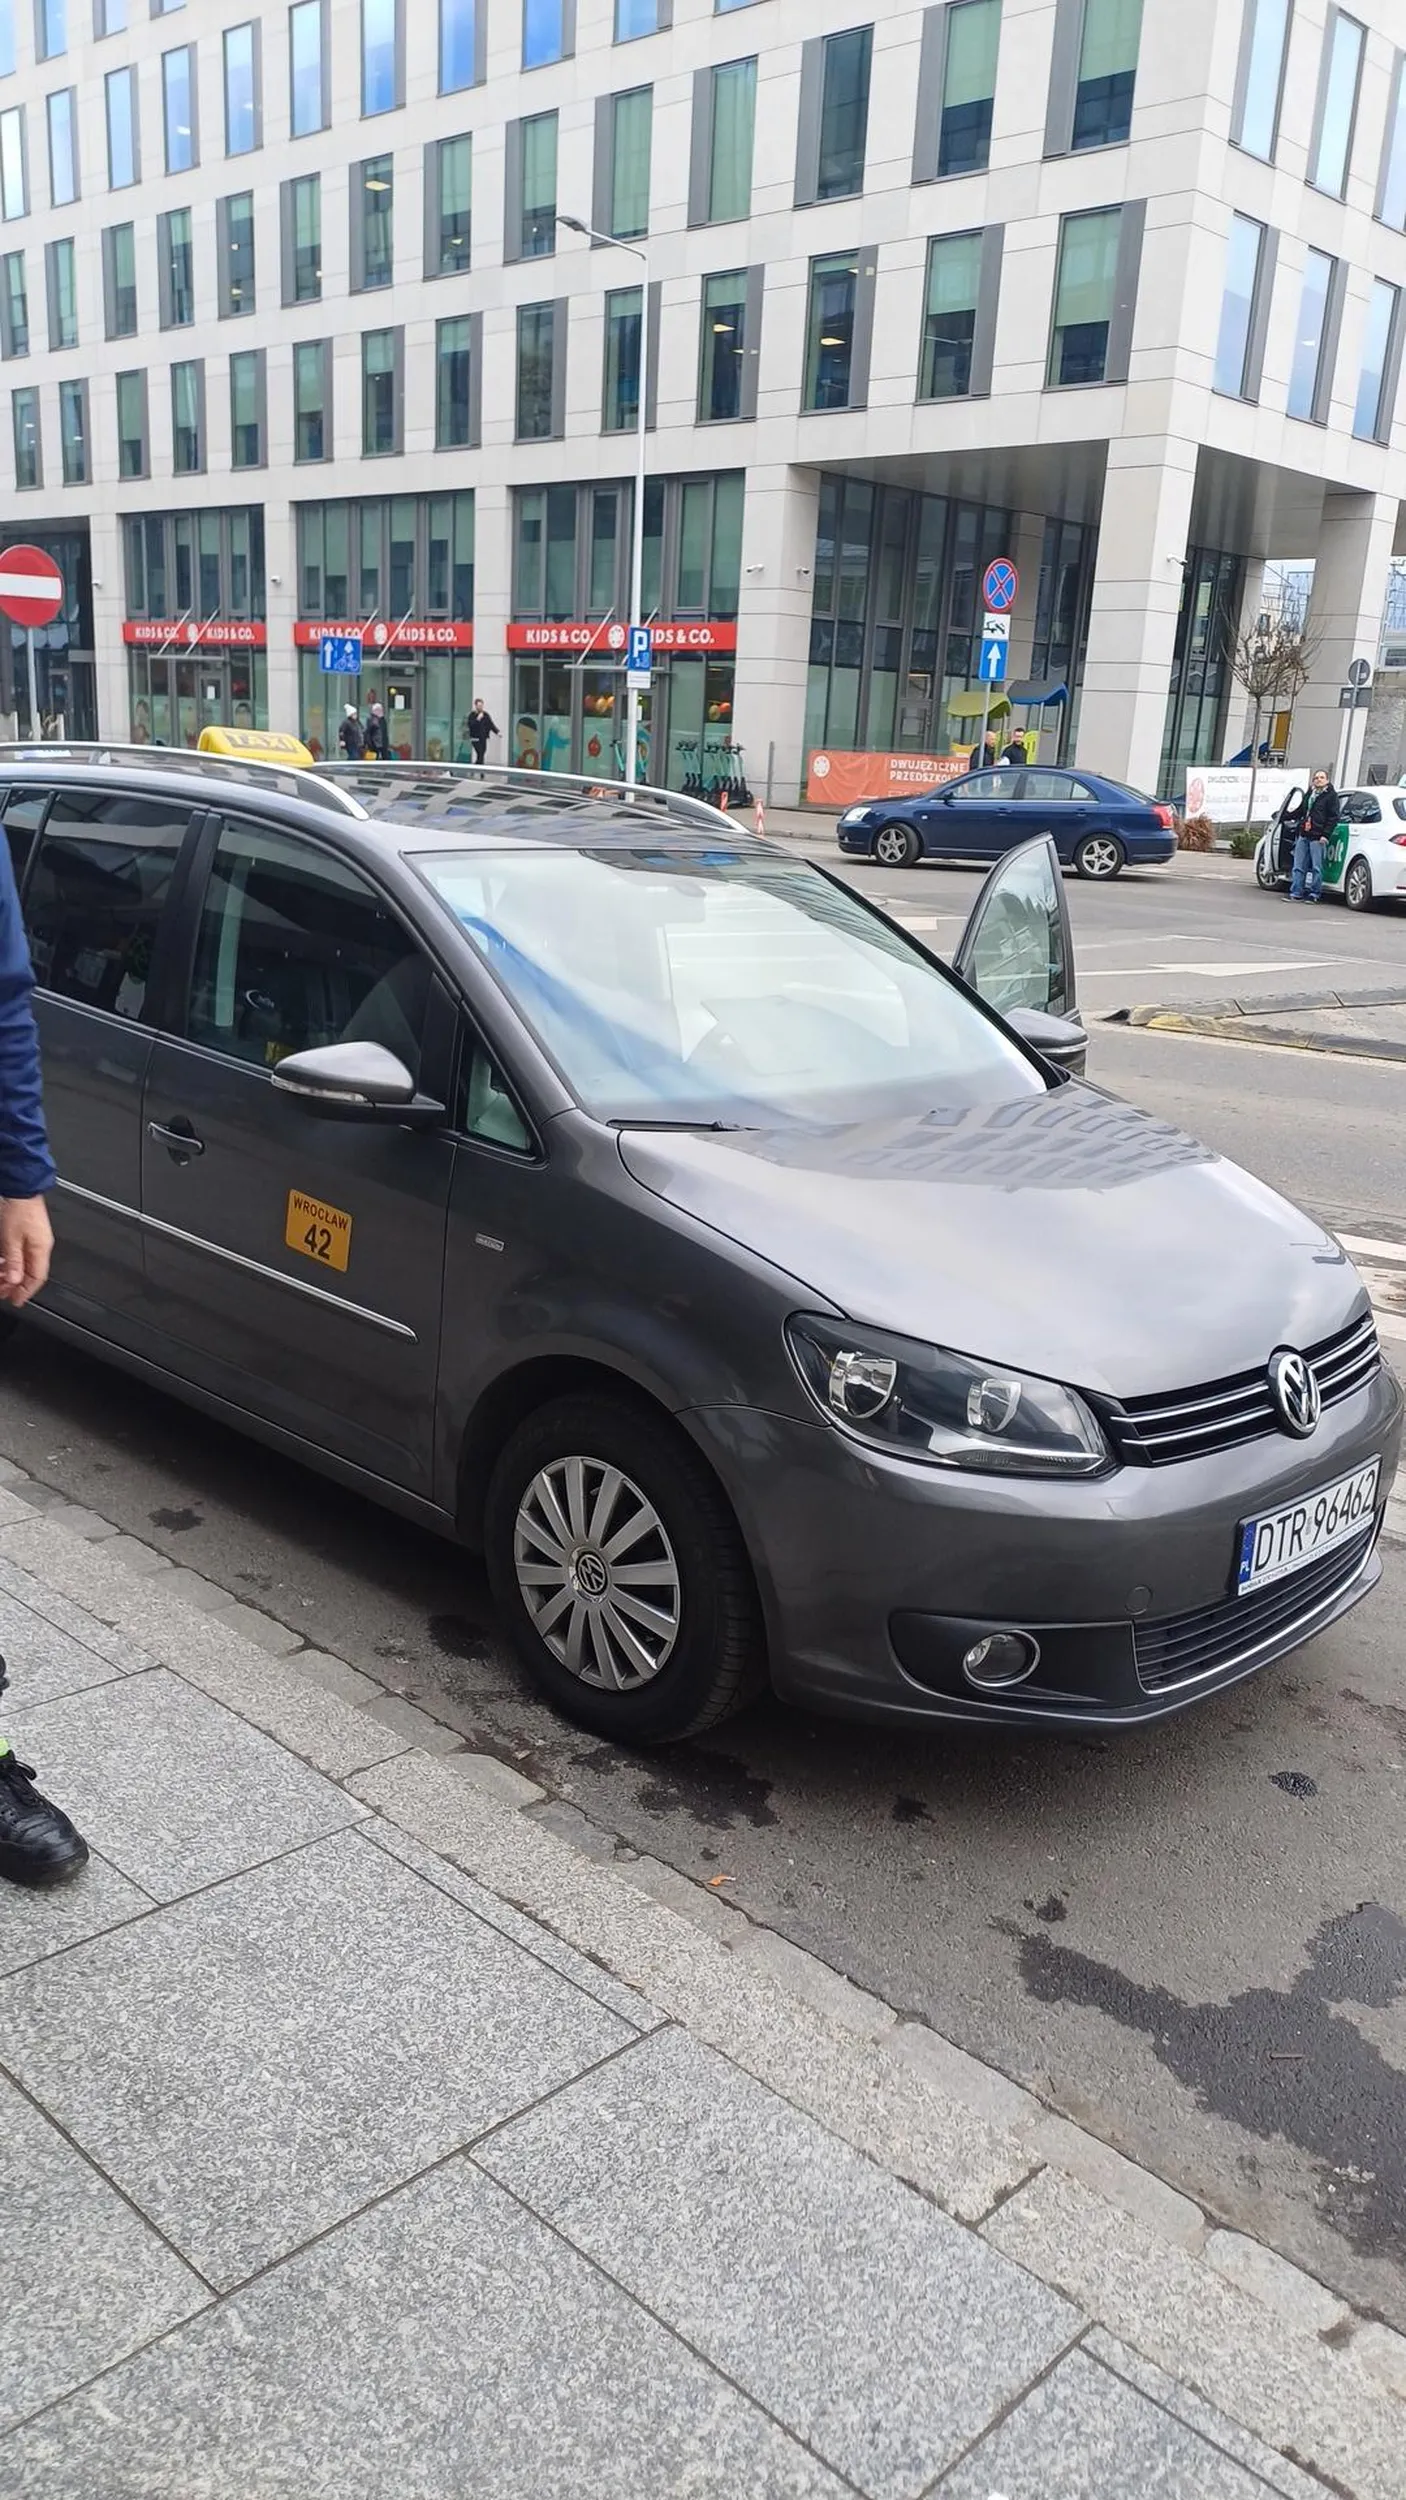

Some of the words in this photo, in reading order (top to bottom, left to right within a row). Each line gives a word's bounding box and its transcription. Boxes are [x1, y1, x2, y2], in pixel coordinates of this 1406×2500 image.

[633, 630, 648, 658] P
[224, 732, 300, 753] TAXI
[890, 759, 966, 773] DWUJĘZYCZNE
[1323, 839, 1344, 862] olt
[293, 1195, 348, 1231] WROCŁAW
[304, 1223, 331, 1260] 42
[1254, 1507, 1307, 1572] DTR
[1312, 1469, 1376, 1545] 96462
